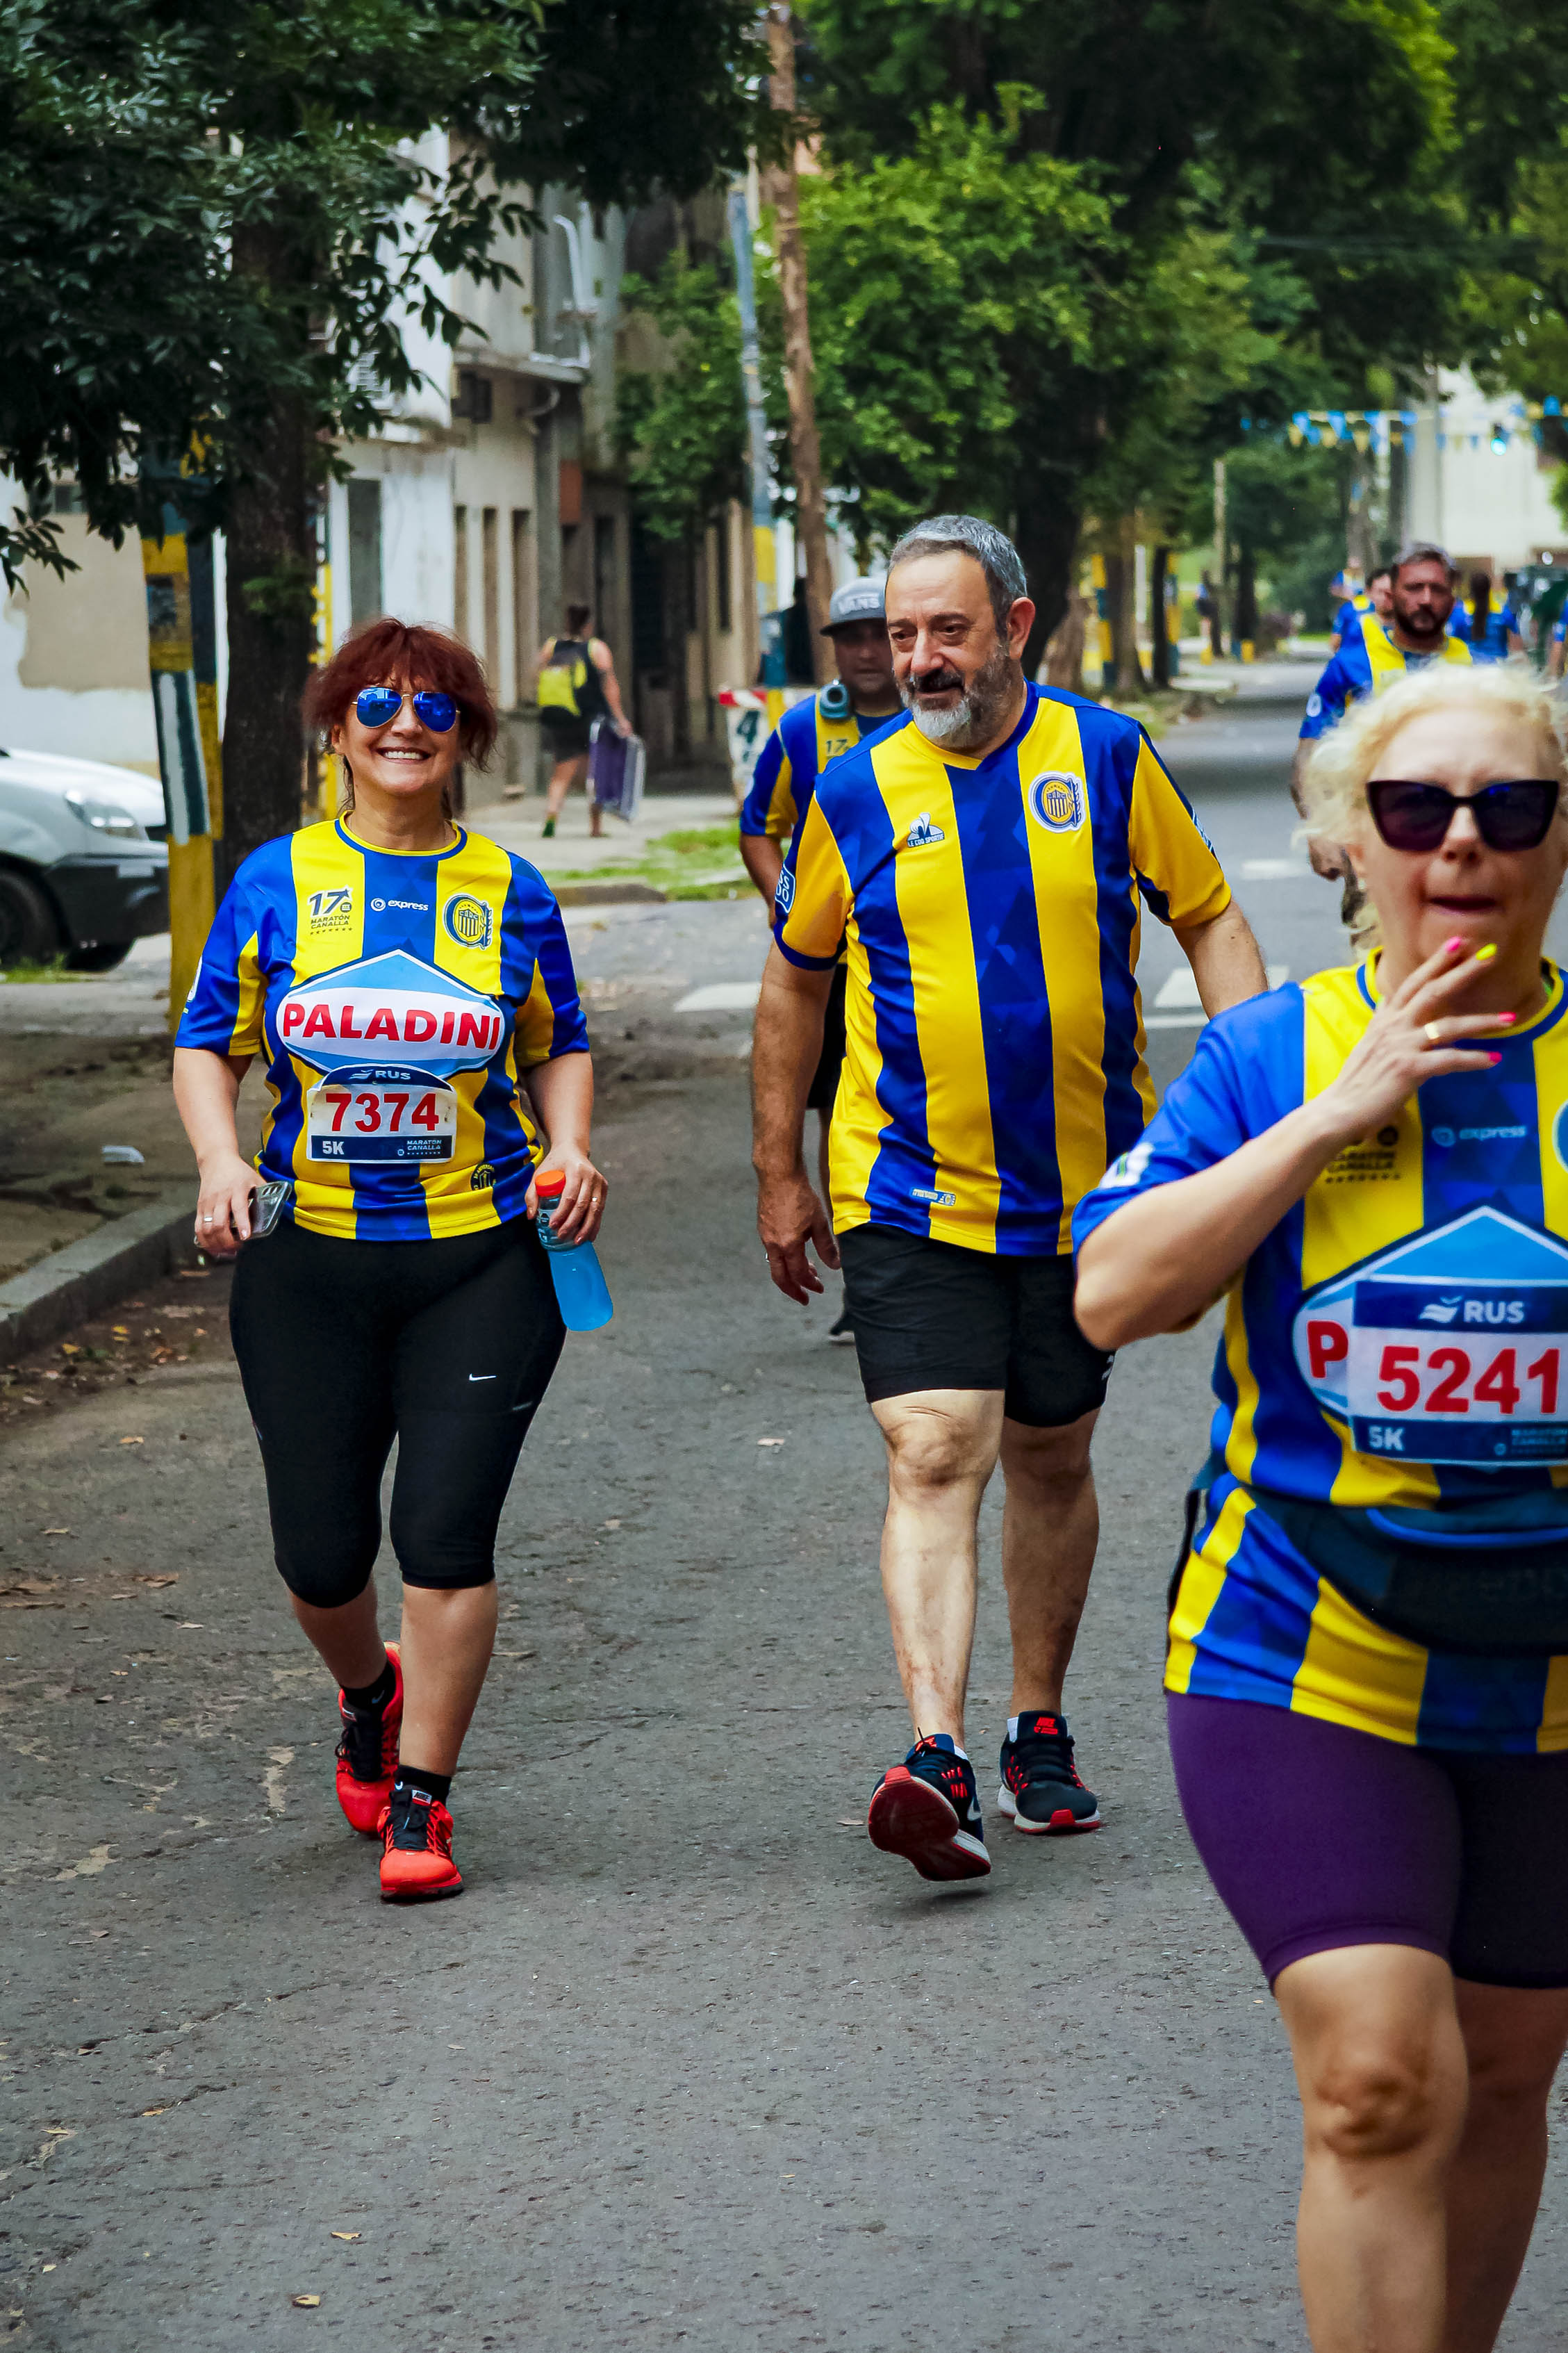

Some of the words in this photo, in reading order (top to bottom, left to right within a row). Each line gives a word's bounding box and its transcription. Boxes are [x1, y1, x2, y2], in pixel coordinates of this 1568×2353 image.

[388, 900, 429, 911] express
[311, 921, 349, 929] CANALLA
[283, 1003, 501, 1050] PALADINI
[375, 1070, 411, 1080] RUS
[326, 1093, 439, 1132] 7374
[322, 1140, 345, 1155] 5K
[1462, 1300, 1525, 1323] RUS
[1376, 1345, 1560, 1415] 5241
[1368, 1426, 1405, 1451] 5K
